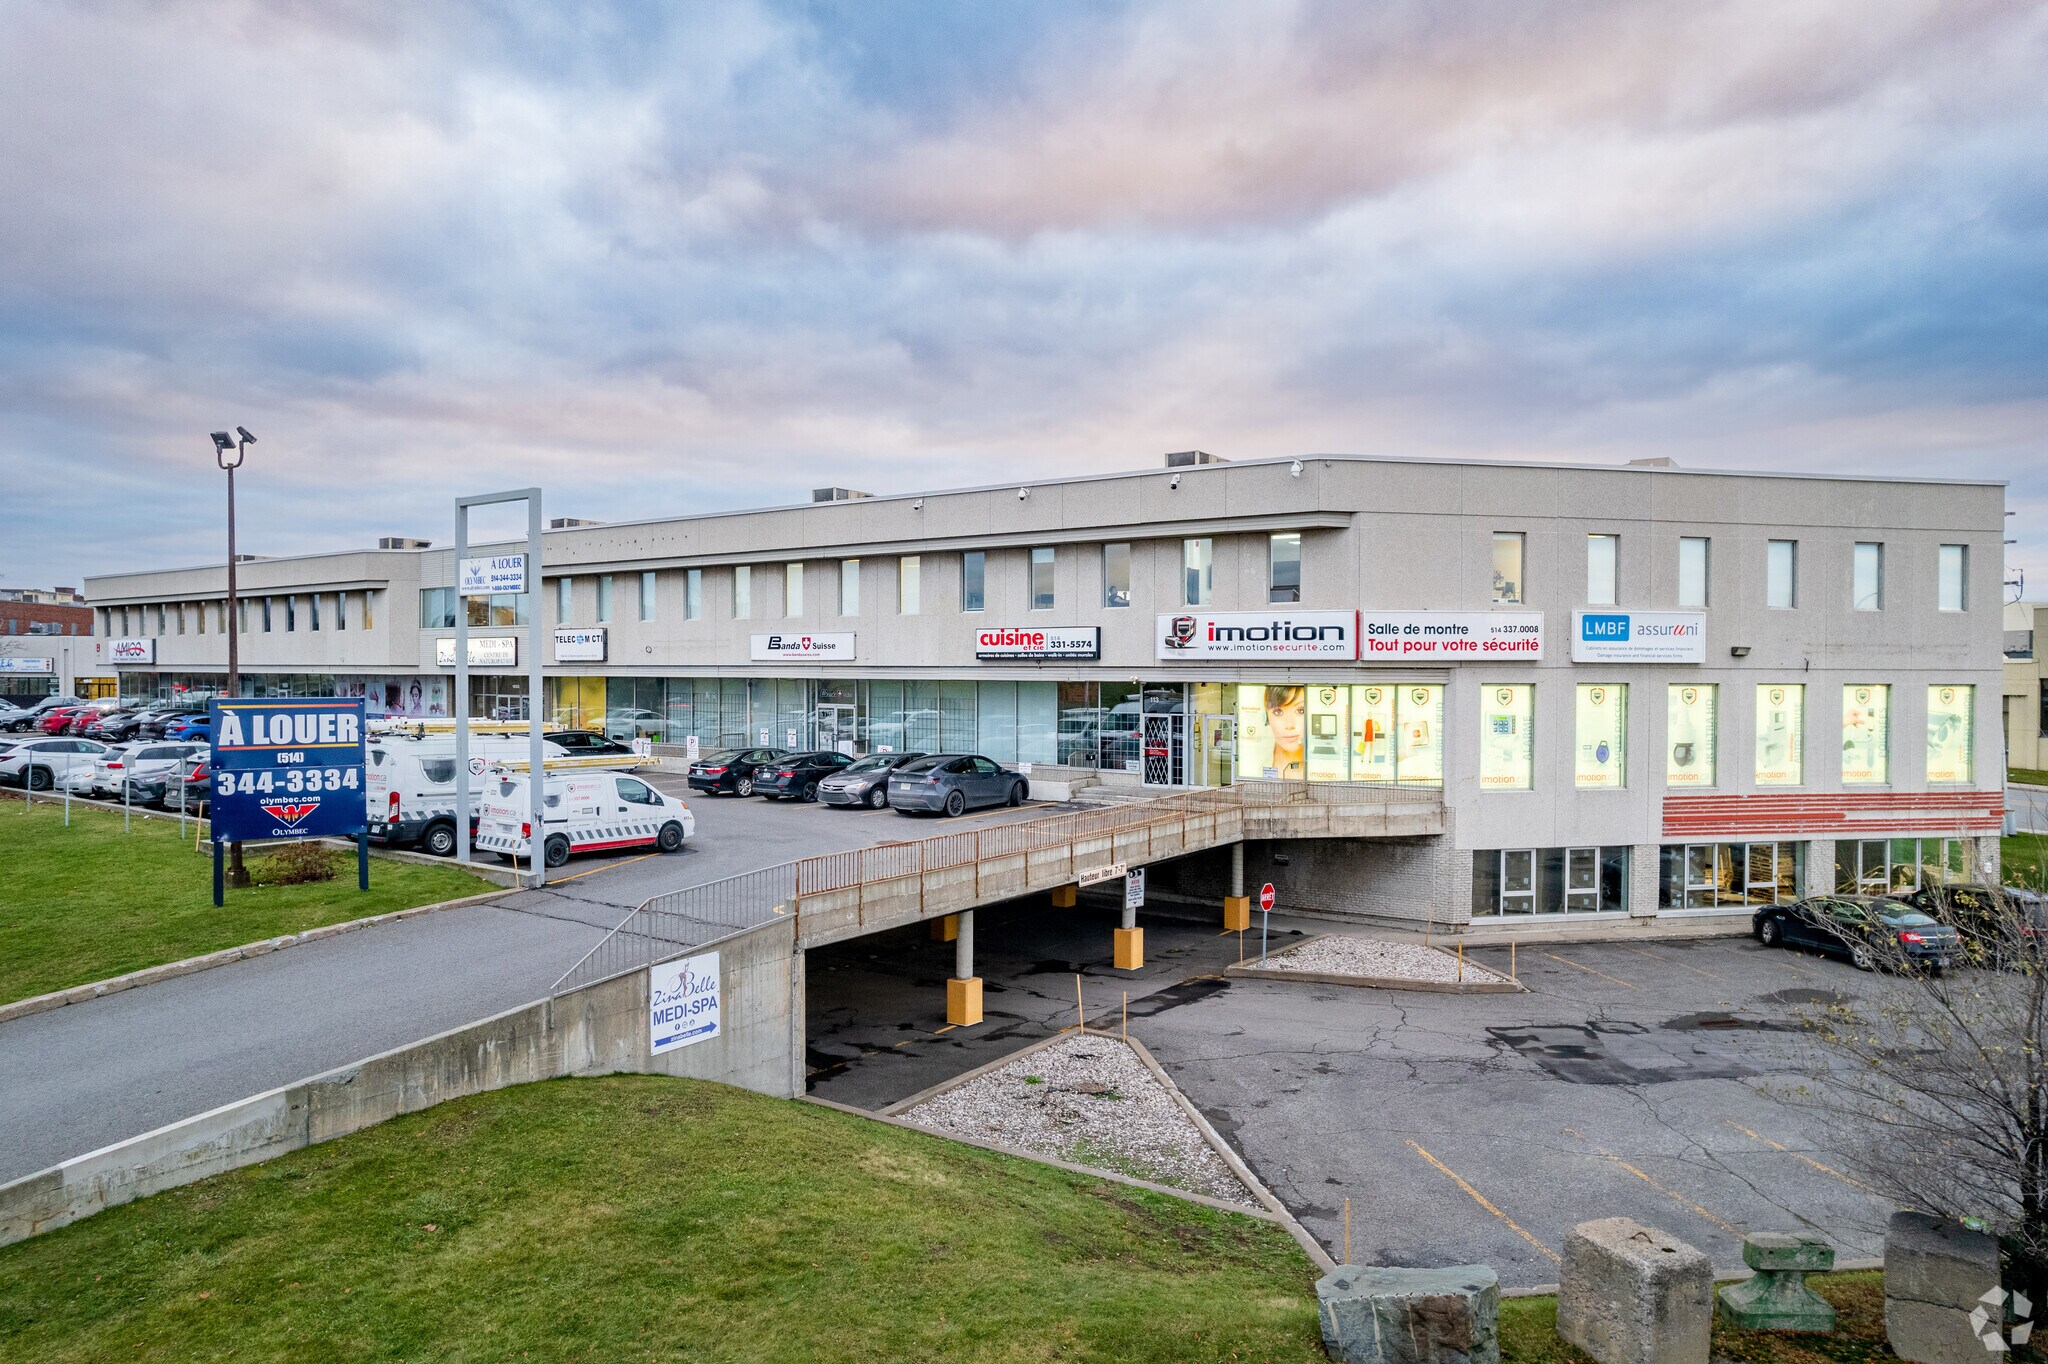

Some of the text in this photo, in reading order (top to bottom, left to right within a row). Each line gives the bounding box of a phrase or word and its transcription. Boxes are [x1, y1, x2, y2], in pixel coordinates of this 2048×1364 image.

[498, 557, 522, 569] LOUER
[465, 576, 486, 585] OLYMBEC
[490, 573, 522, 582] 514-344-3334
[1207, 621, 1345, 642] imotion
[1368, 623, 1469, 635] Salle de montre
[1503, 625, 1539, 634] 337.0008
[1585, 621, 1627, 635] LMBF
[592, 634, 603, 643] CTI
[767, 636, 836, 650] Banda Suisse
[979, 628, 1044, 646] cuisine
[479, 640, 496, 649] MEDI
[501, 639, 514, 648] SPA
[1050, 640, 1093, 649] 331-5574
[1207, 644, 1345, 652] www.imotionsecurite.com
[1368, 637, 1539, 654] Tout pour votre sécurité
[1150, 696, 1159, 704] 113
[218, 709, 359, 746] À LOUER
[277, 752, 304, 764] (514)
[217, 768, 359, 796] 344-3334
[260, 795, 321, 806] olymbec.com
[272, 827, 309, 837] OLYMBEC
[1080, 872, 1100, 883] Hauteur
[1101, 868, 1113, 878] libre
[653, 990, 682, 1007] Zina
[653, 995, 718, 1026] MEDI-SPA
